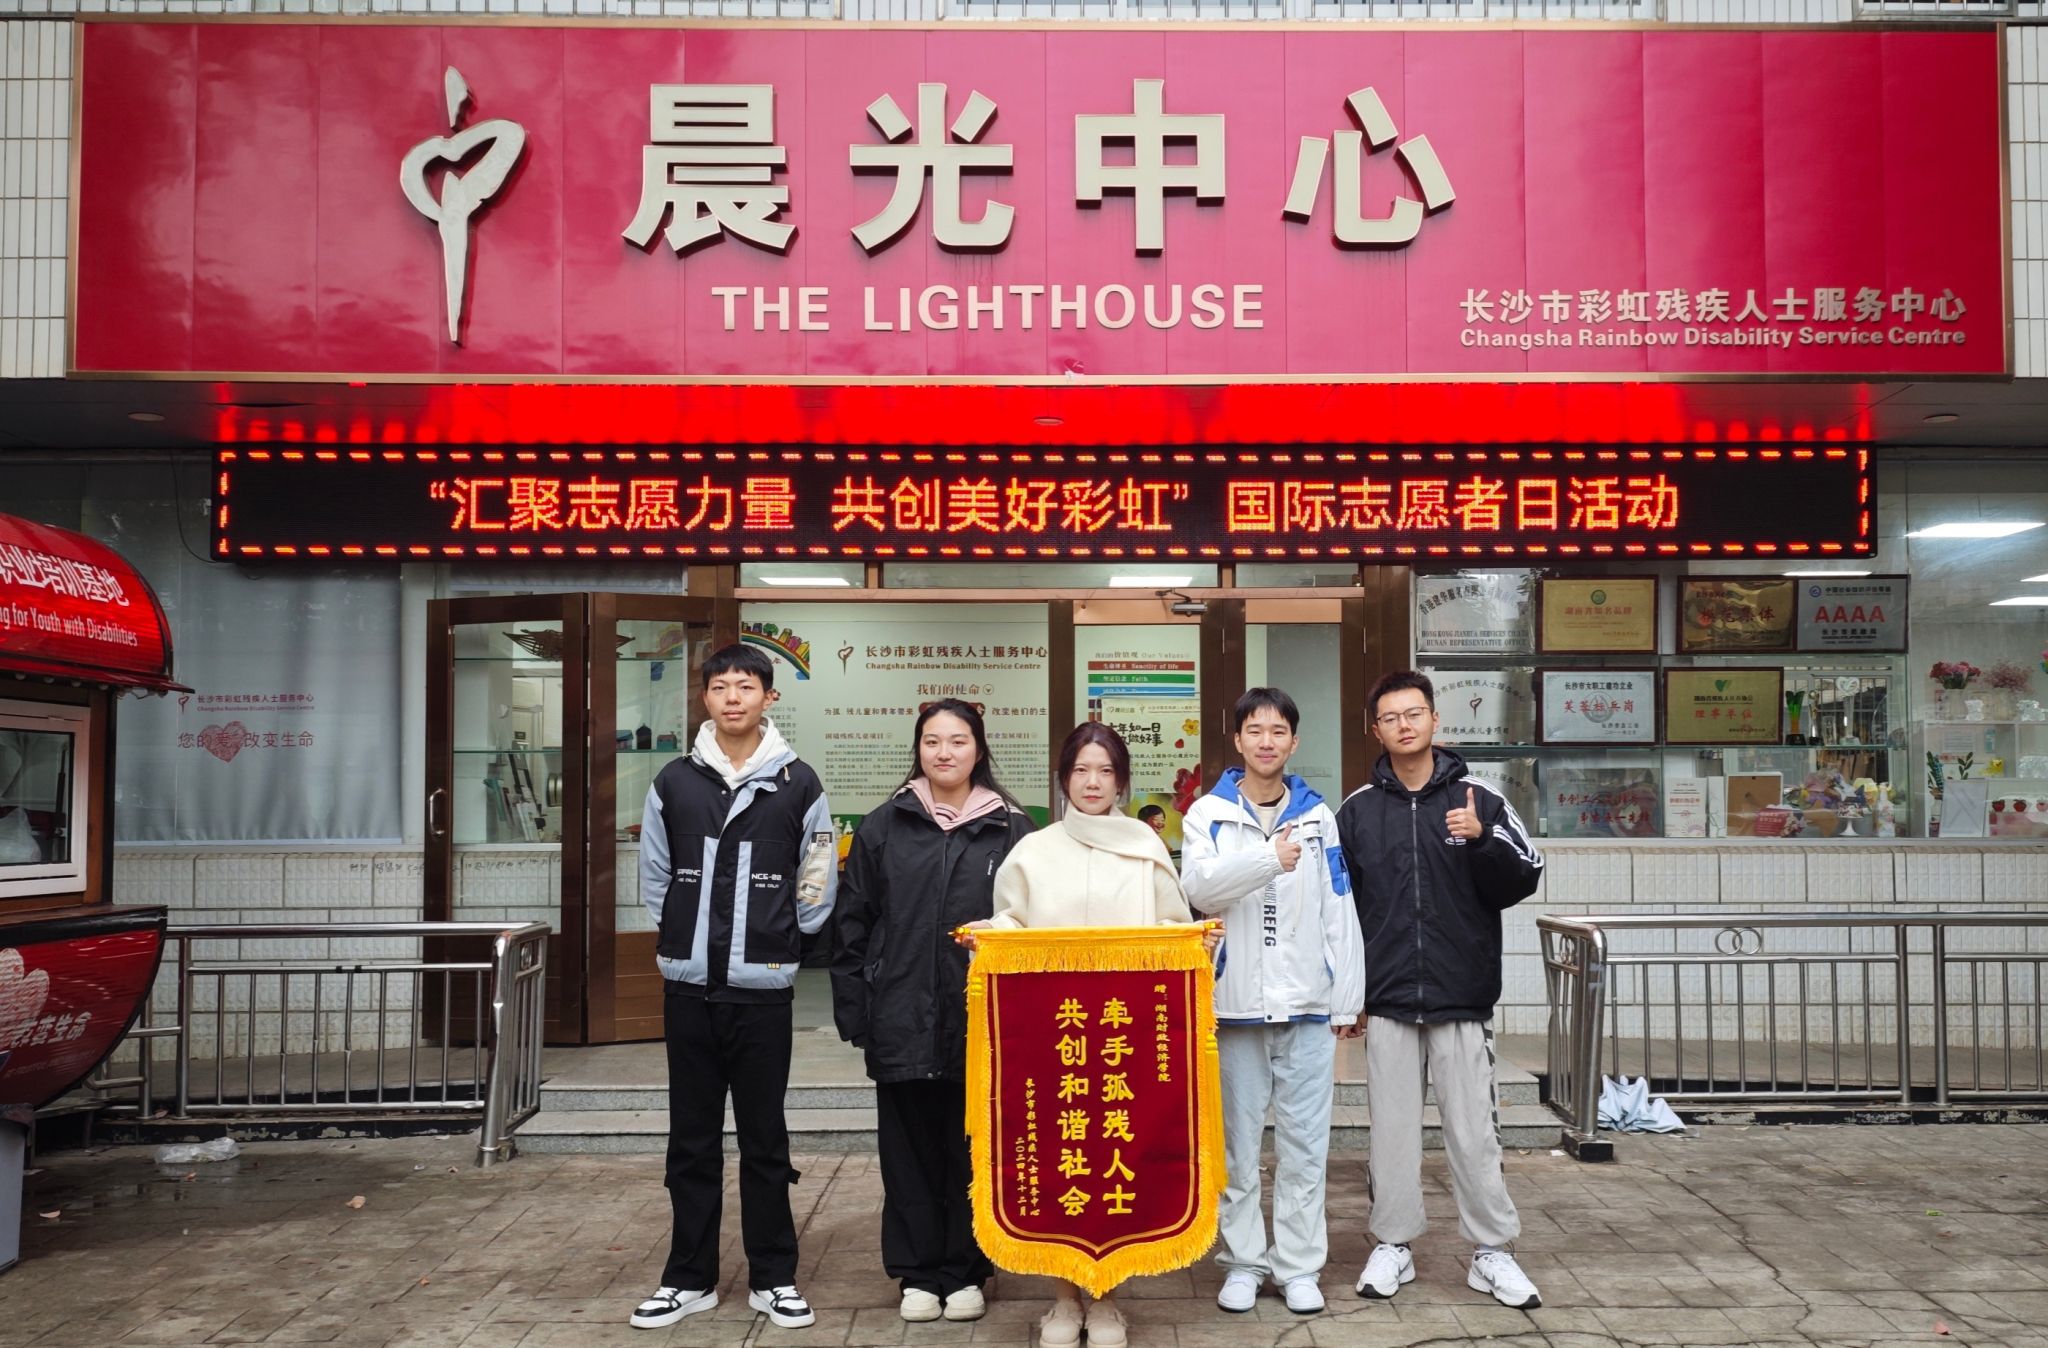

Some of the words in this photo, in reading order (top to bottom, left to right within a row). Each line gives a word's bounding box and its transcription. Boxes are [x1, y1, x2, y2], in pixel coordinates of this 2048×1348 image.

[621, 78, 1455, 257] 晨光中心
[712, 286, 829, 331] THE
[863, 284, 1265, 331] LIGHTHOUSE
[1460, 288, 1967, 324] 长沙市彩虹残疾人士服务中心
[1460, 329, 1573, 351] Changsha
[1579, 329, 1679, 347] Rainbow
[1684, 328, 1793, 349] Disability
[1799, 327, 1883, 346] Service
[1888, 327, 1967, 346] Centre
[1227, 475, 1679, 533] 国际志愿者日活动
[12, 602, 29, 627] for
[30, 606, 62, 633] Youth
[63, 616, 86, 639] with
[87, 617, 138, 647] Disabilities
[1814, 605, 1885, 623] AAAA
[865, 645, 1048, 658] 长沙市彩虹残疾人士服务中心
[1421, 630, 1437, 638] HONG
[1438, 630, 1453, 638] KONG
[1426, 639, 1447, 647] HUNAN
[865, 662, 905, 671] Changsha
[907, 662, 941, 670] Rainbow
[943, 662, 981, 671] Disability
[983, 662, 1013, 670] Service
[1014, 662, 1042, 670] Centre
[917, 684, 980, 696] 我们的使命
[1055, 998, 1091, 1216] 共创和谐社会
[1099, 997, 1136, 1216] 牵手孤残人士
[1025, 1078, 1040, 1216] 长沙市彩虹残疾人士服务中心
